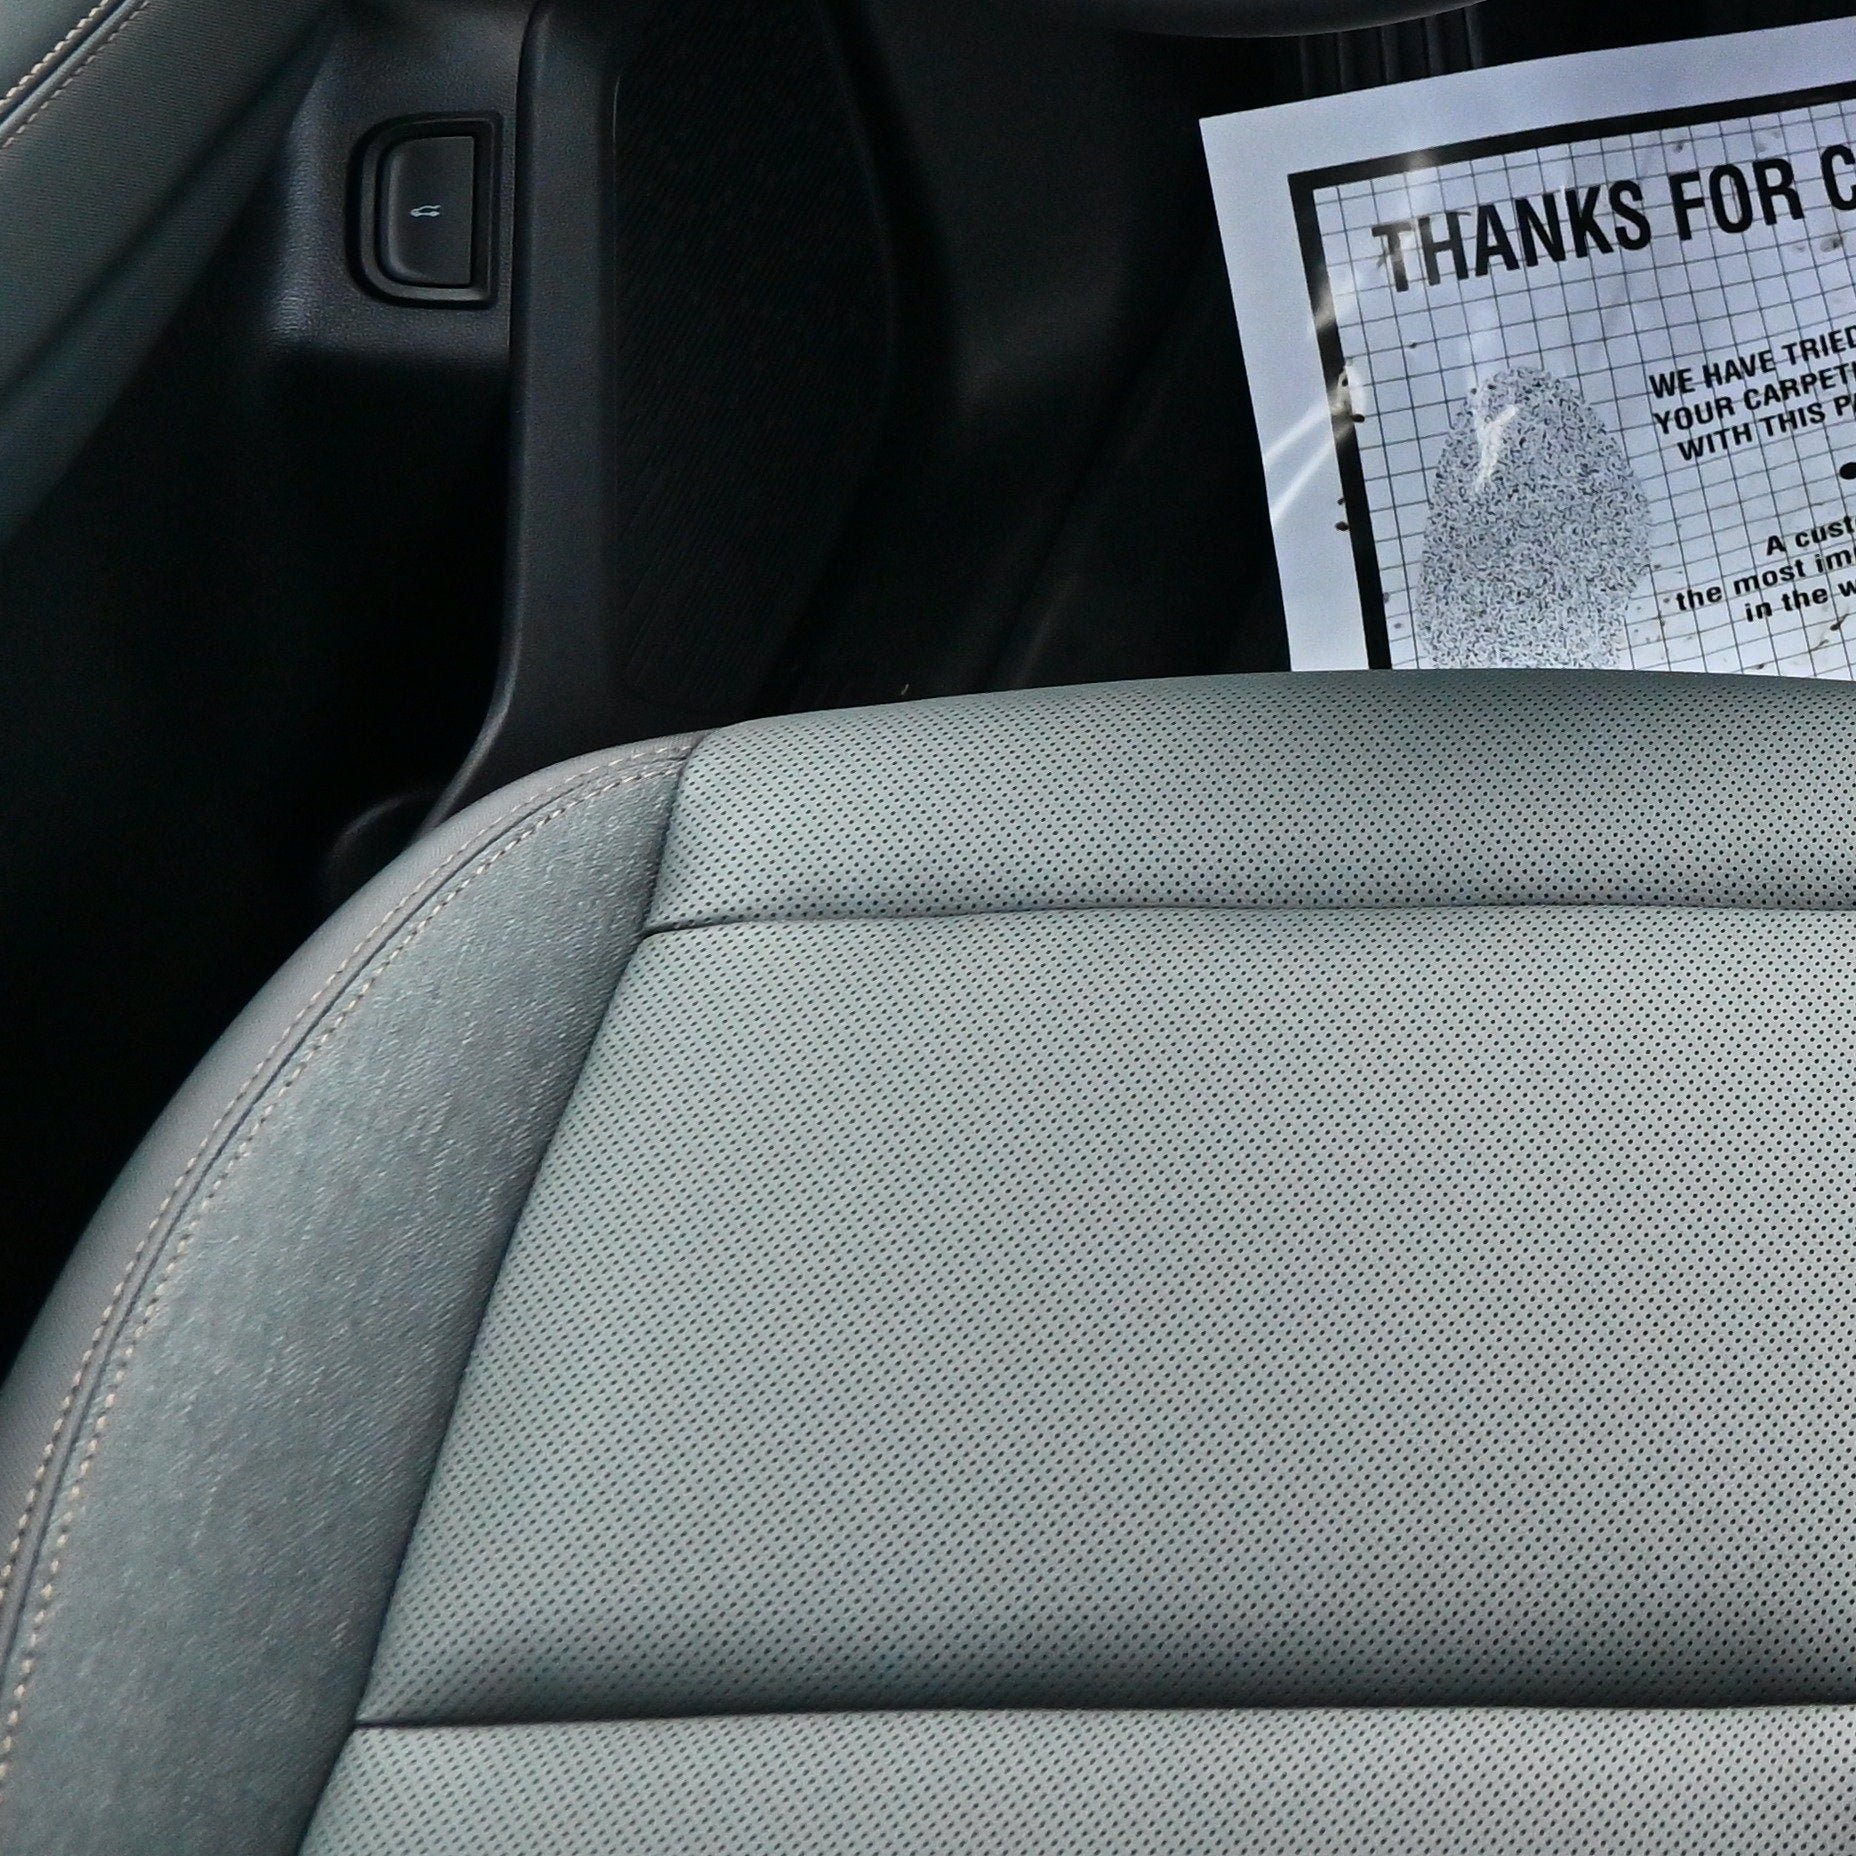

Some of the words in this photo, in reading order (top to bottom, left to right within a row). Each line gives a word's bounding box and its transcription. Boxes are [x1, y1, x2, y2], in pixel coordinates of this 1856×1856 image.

[1371, 179, 1652, 293] THANKS
[1670, 157, 1805, 241] FOR
[1648, 367, 1696, 399] WE
[1703, 349, 1777, 389] HAVE
[1652, 397, 1736, 435] YOUR
[1677, 423, 1753, 462] WITH
[1759, 402, 1827, 438] THIS
[1765, 535, 1788, 556] A
[1676, 585, 1723, 611] the
[1733, 560, 1806, 596] most
[1744, 601, 1774, 623] in
[1781, 586, 1829, 613] the
